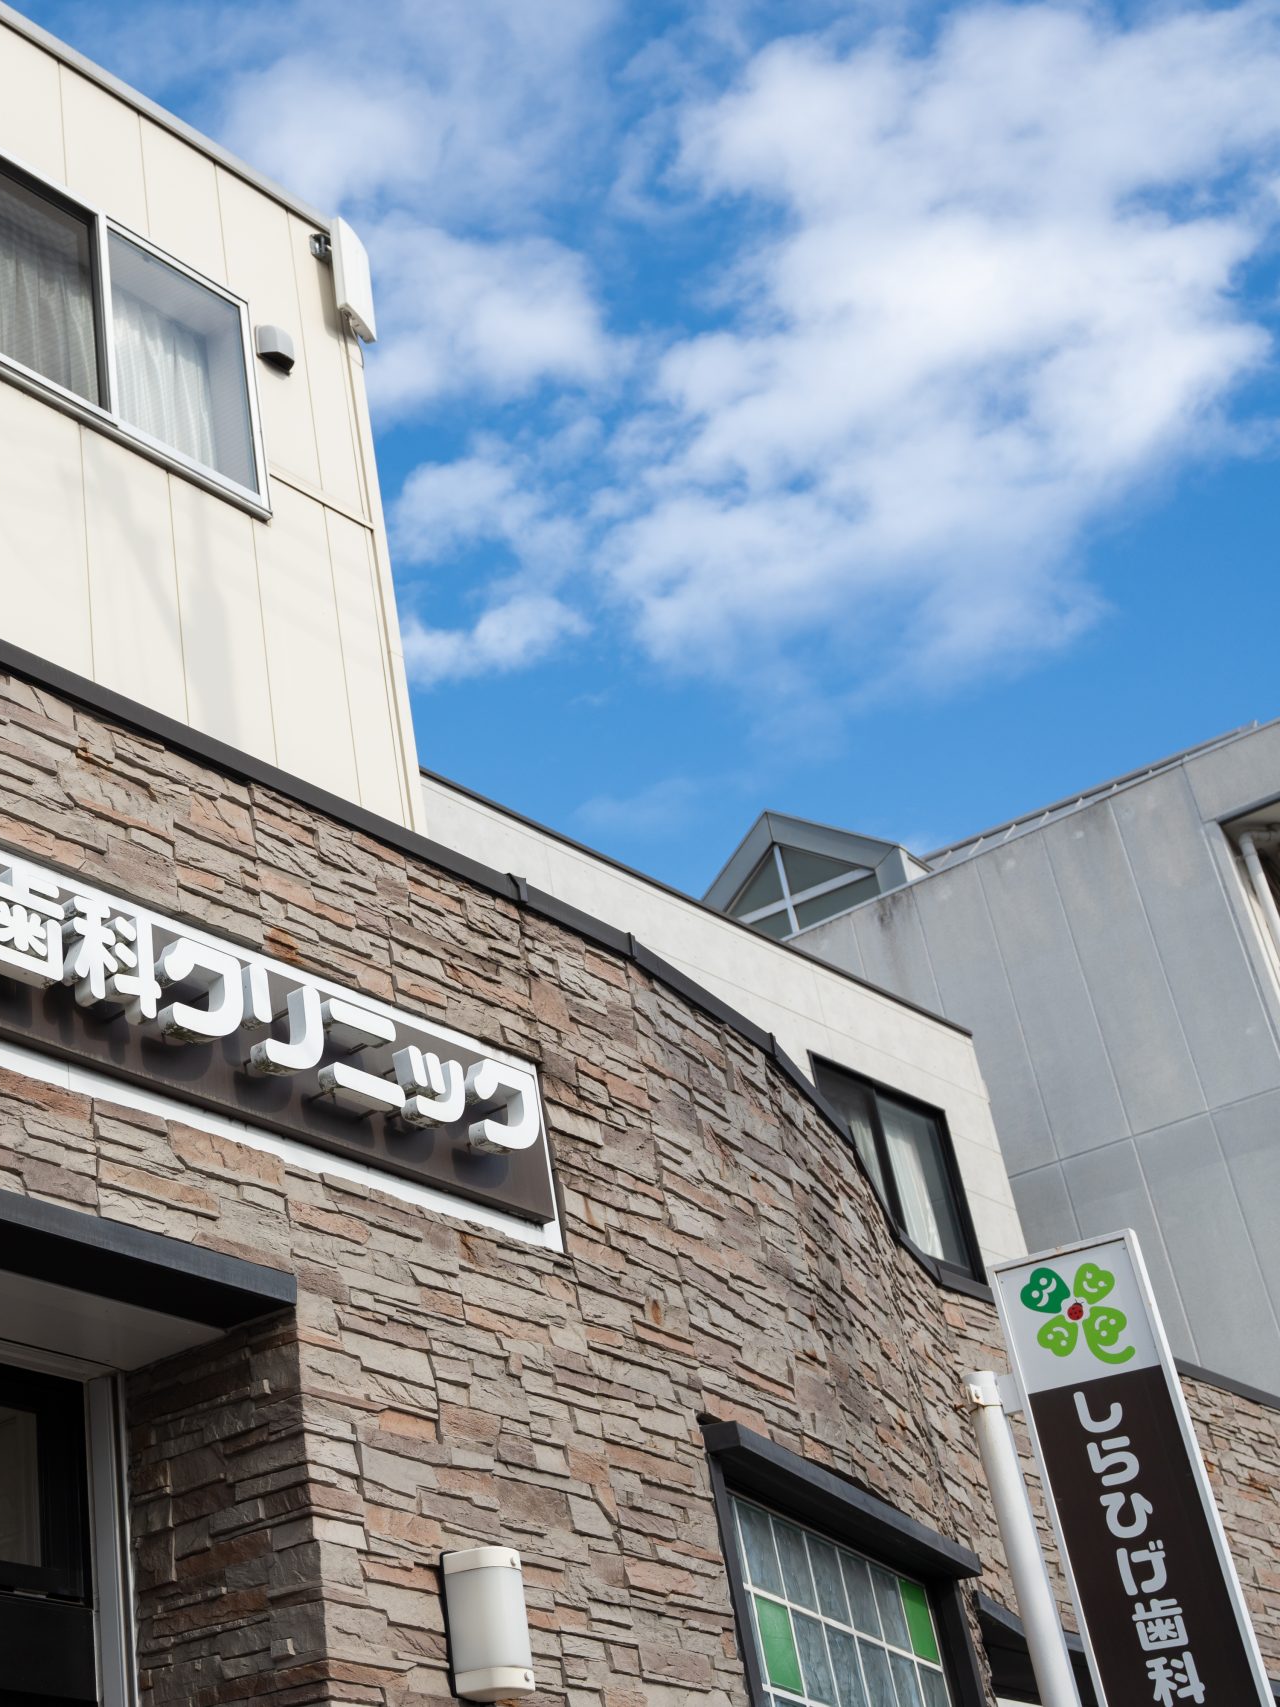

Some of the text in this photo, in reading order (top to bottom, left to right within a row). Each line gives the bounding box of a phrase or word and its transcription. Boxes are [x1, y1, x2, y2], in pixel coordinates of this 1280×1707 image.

[1073, 1391, 1205, 1707] しらひげ歯科
